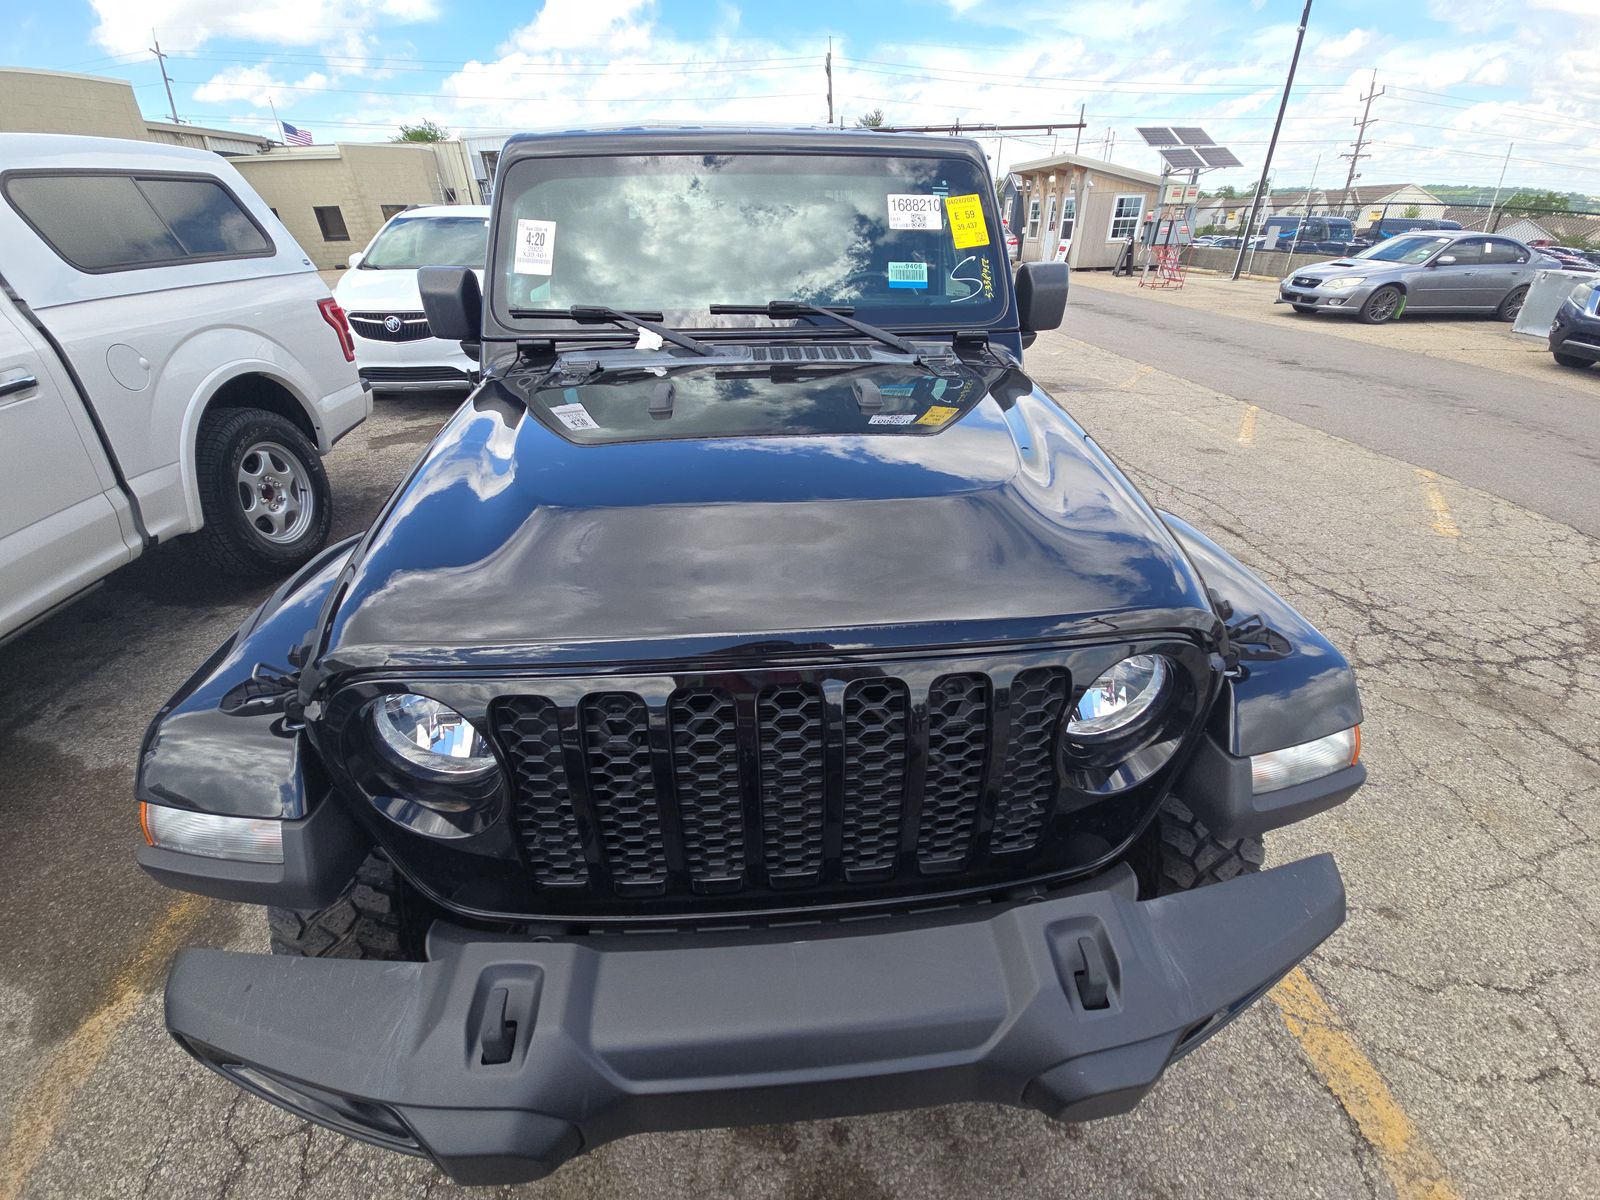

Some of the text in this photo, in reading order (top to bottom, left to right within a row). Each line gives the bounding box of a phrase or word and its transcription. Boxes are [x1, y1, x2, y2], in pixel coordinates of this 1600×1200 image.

[891, 198, 941, 212] 1688210
[954, 210, 975, 221] E 59
[526, 231, 545, 247] 4:20
